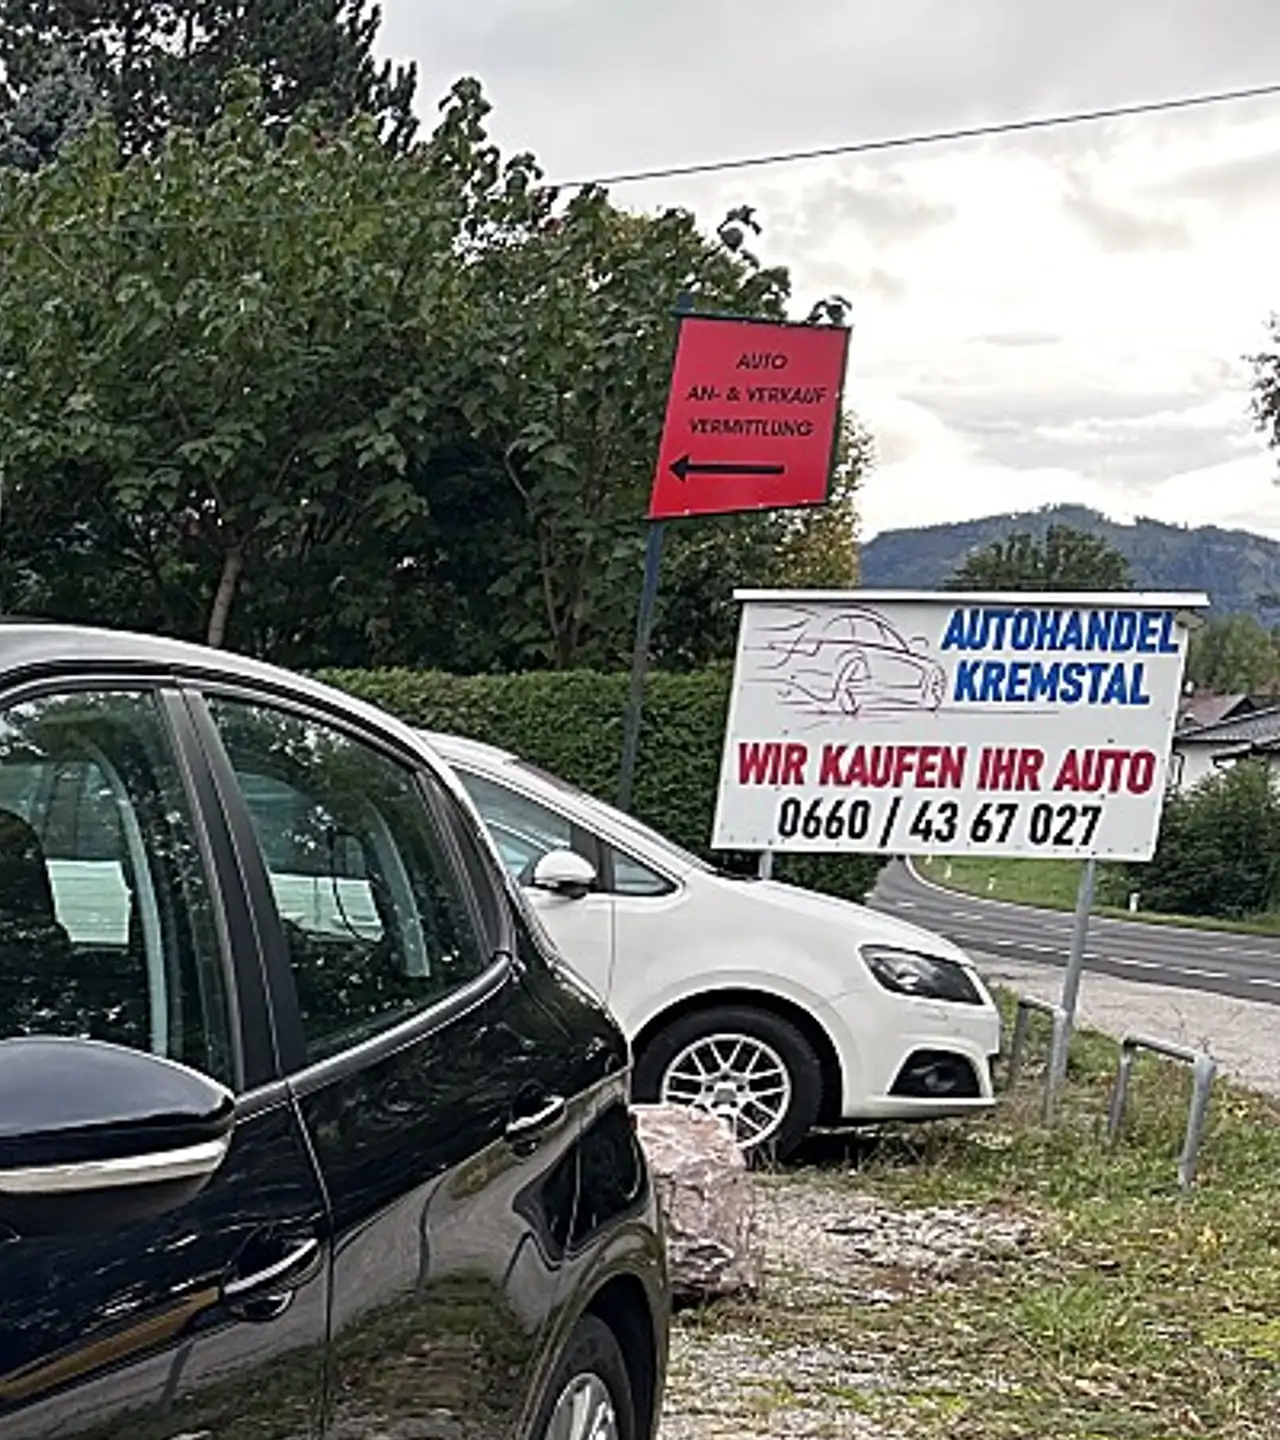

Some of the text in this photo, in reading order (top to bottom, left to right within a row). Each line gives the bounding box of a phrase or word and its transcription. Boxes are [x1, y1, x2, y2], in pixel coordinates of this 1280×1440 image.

[736, 353, 788, 369] AUTO
[686, 385, 828, 404] AN- & VERKAUF
[689, 418, 814, 437] VERMITTLUNG
[940, 608, 1179, 653] AUTOHANDEL
[953, 660, 1150, 705] KREMSTAL
[738, 742, 1156, 795] WIR KAUFEN IHR AUTO
[778, 796, 1102, 848] 0660 / 43 67 027
